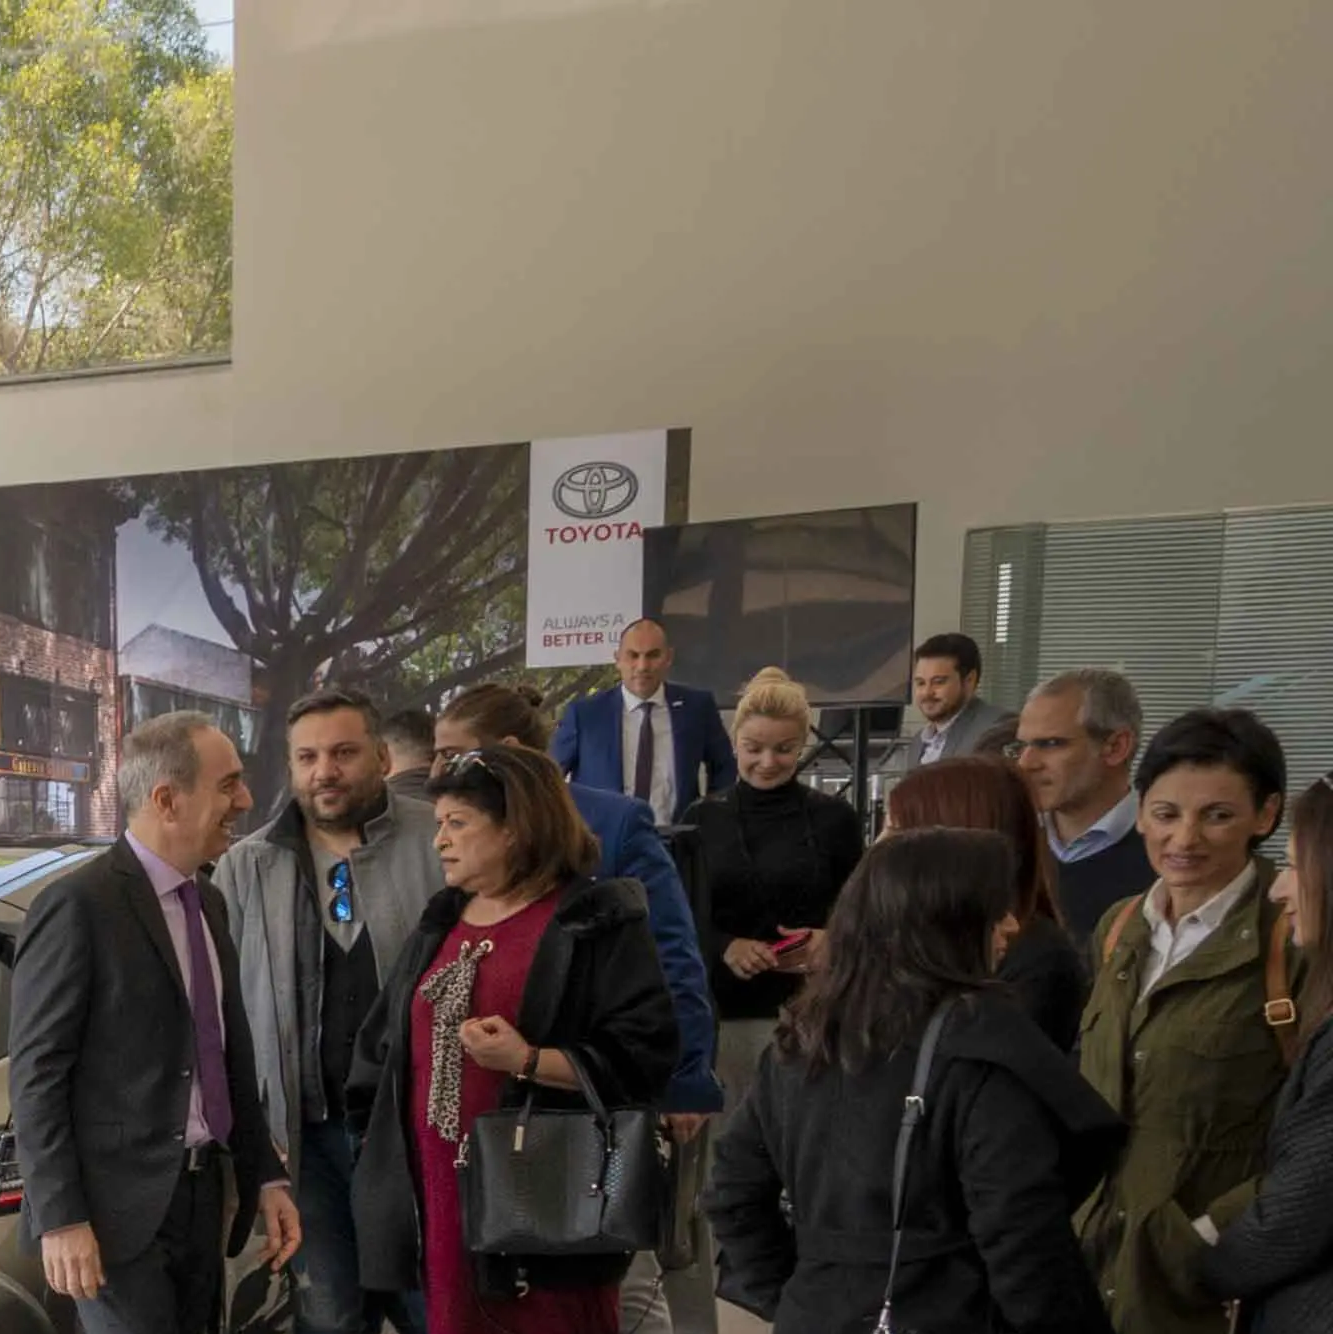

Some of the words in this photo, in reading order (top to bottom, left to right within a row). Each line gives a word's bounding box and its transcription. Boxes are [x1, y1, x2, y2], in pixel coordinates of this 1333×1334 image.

[545, 521, 644, 545] TOYOTA
[542, 613, 610, 631] ALWAYS
[543, 631, 605, 648] BETTER
